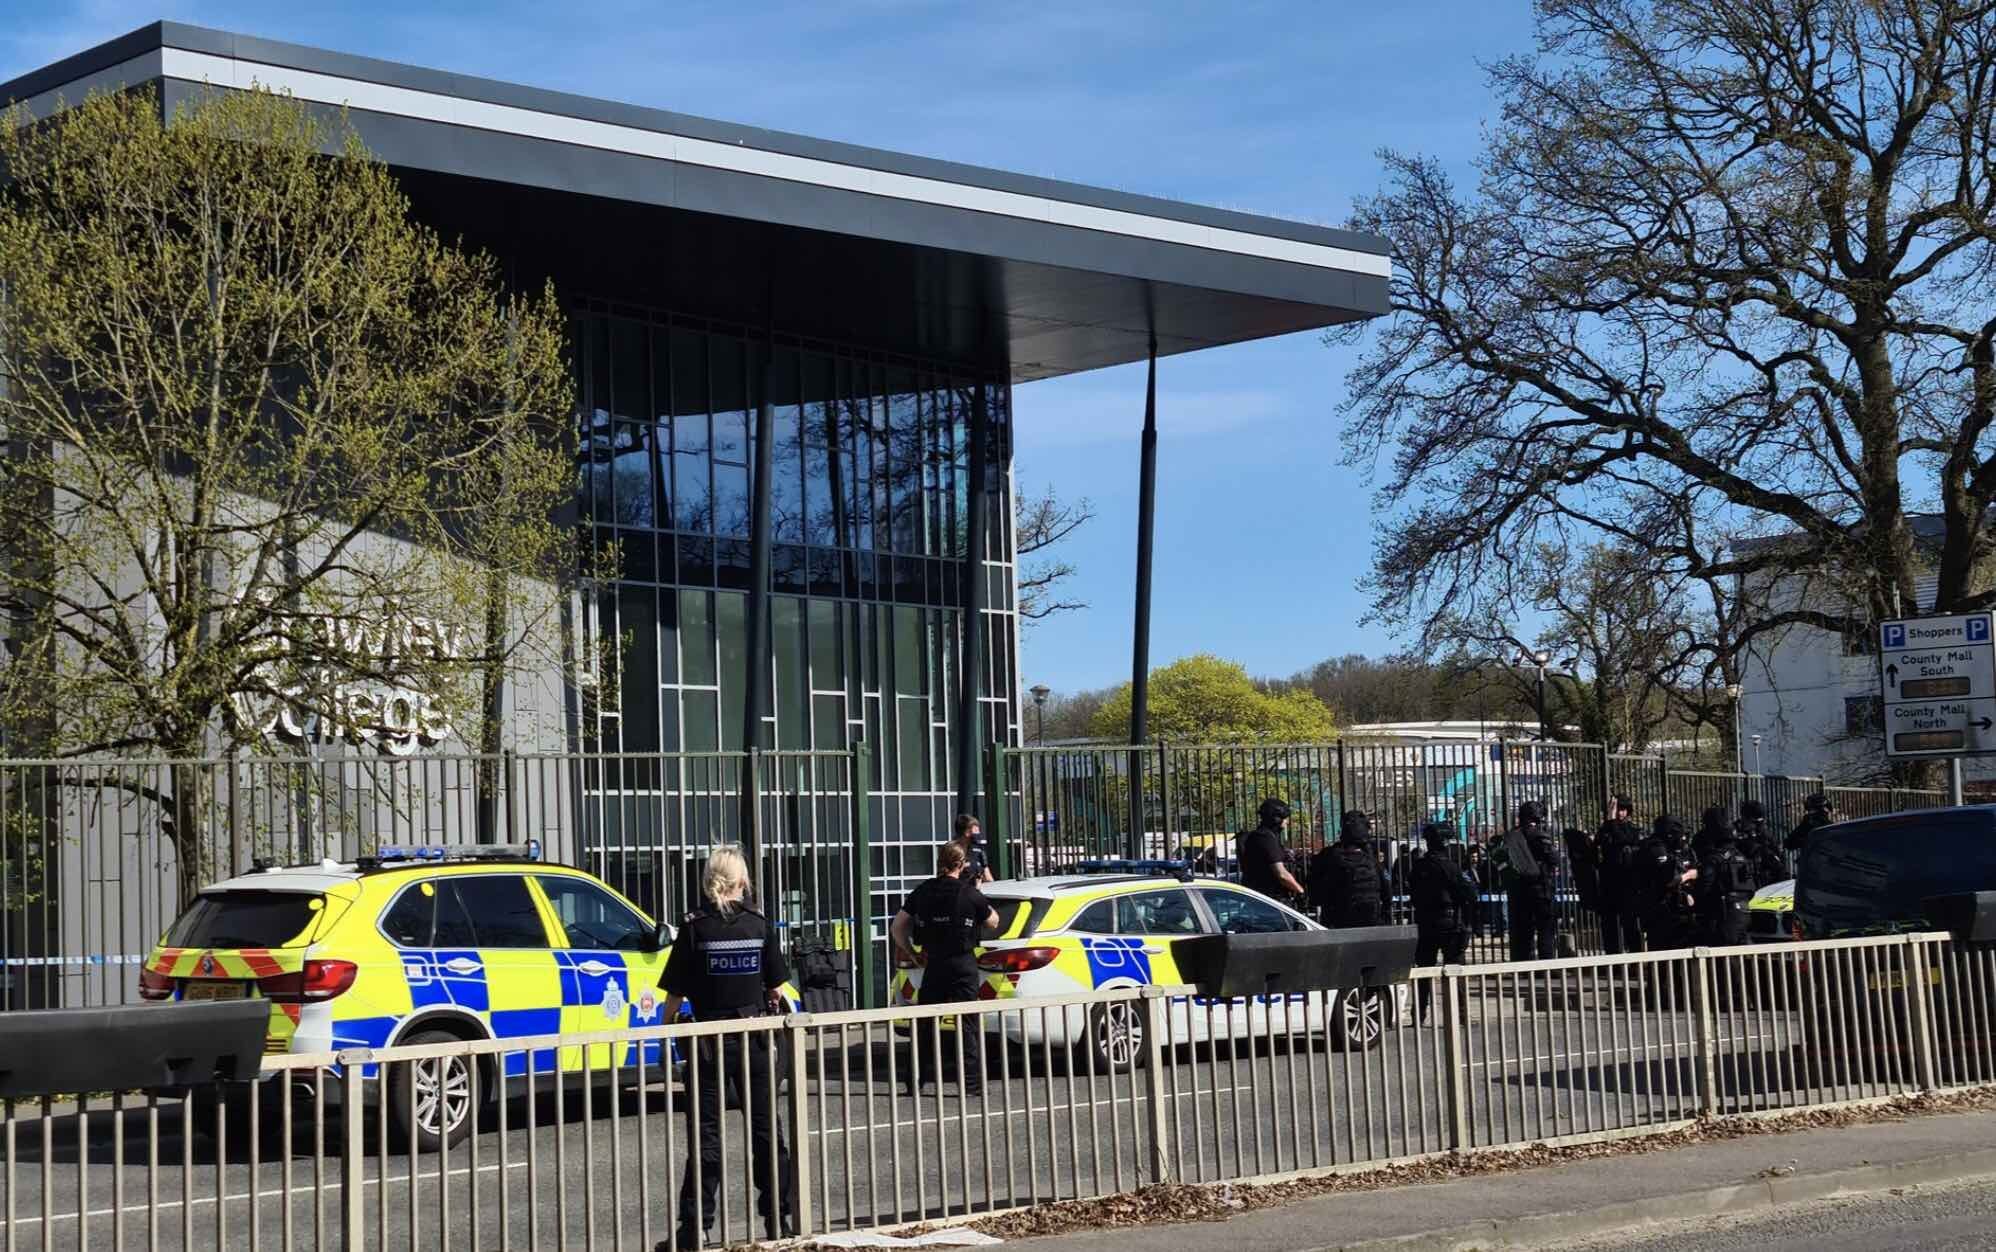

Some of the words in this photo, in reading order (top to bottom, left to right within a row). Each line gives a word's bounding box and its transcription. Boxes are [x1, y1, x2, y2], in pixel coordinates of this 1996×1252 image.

[1888, 626, 1901, 645] P
[1909, 626, 1963, 639] Shoppers
[1971, 620, 1985, 640] P
[1901, 653, 1942, 665] County
[1948, 651, 1973, 662] Mall
[1920, 665, 1954, 677] South
[1894, 706, 1935, 718] County
[1940, 704, 1966, 716] Mall
[1913, 717, 1947, 729] North
[710, 956, 758, 969] POLICE
